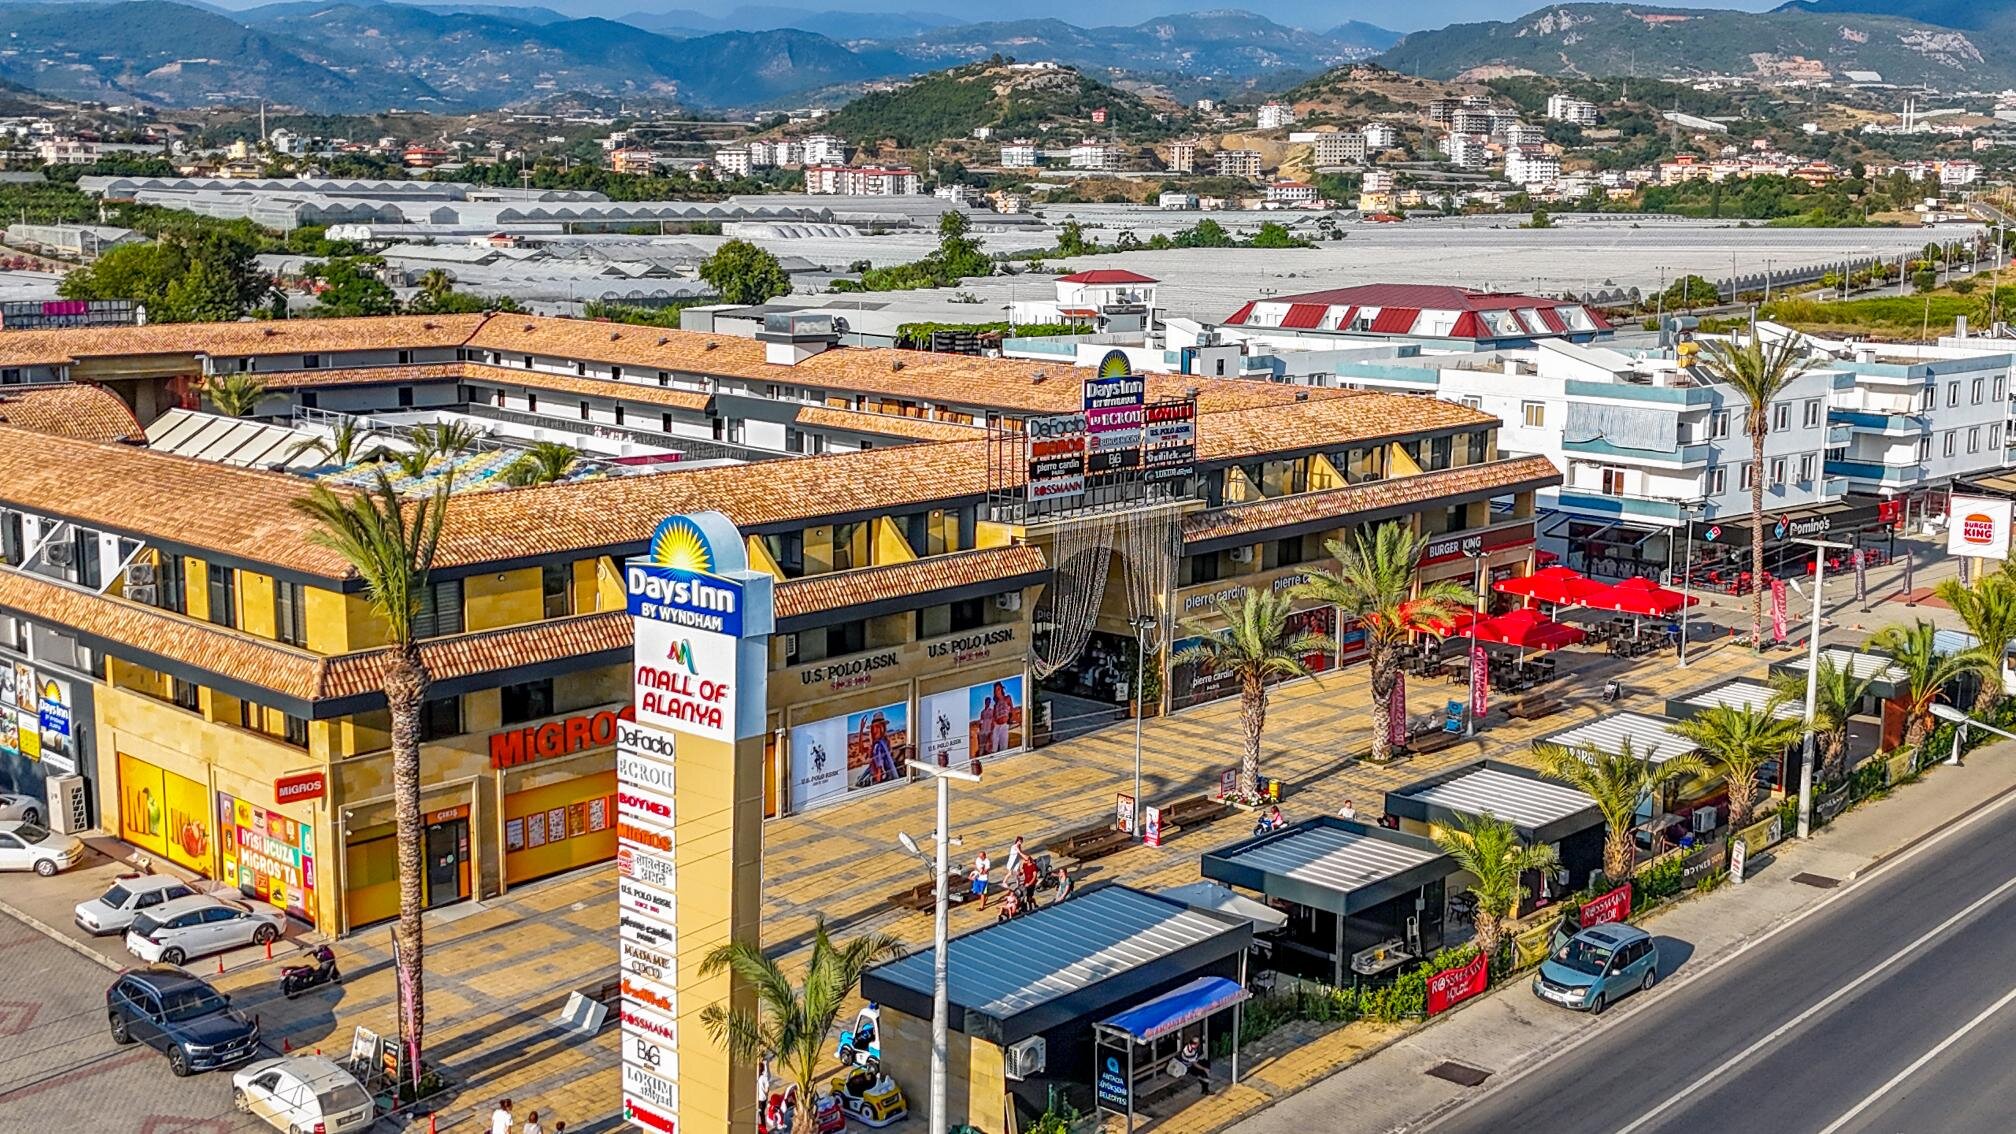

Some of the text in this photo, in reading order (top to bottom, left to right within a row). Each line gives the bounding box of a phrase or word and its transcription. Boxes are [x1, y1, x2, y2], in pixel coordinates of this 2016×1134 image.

[1031, 416, 1085, 437] DeFacto
[1037, 460, 1080, 474] pierre cardin
[1034, 481, 1083, 496] ROSSMANN
[1964, 522, 1992, 530] BURGER
[1964, 529, 1992, 538] KING
[1429, 537, 1481, 558] BURGER KING
[1273, 575, 1300, 593] pierre
[1185, 585, 1247, 612] pierre cardin
[641, 602, 724, 632] BY WYNDHAM
[928, 629, 1015, 658] U.S. POLO ASSN.
[801, 652, 898, 684] U.S. POLO ASSN.
[1192, 670, 1234, 688] pierre cardin
[637, 666, 729, 704] MALL OF
[642, 692, 723, 729] ALANYA
[617, 726, 673, 757] DeFacto
[618, 792, 671, 818] BOYNER
[263, 837, 294, 865] UCUZA
[634, 889, 651, 901] POLO
[624, 944, 670, 969] MADAME
[632, 961, 662, 979] COCO
[619, 1011, 674, 1041] ROSSMANN
